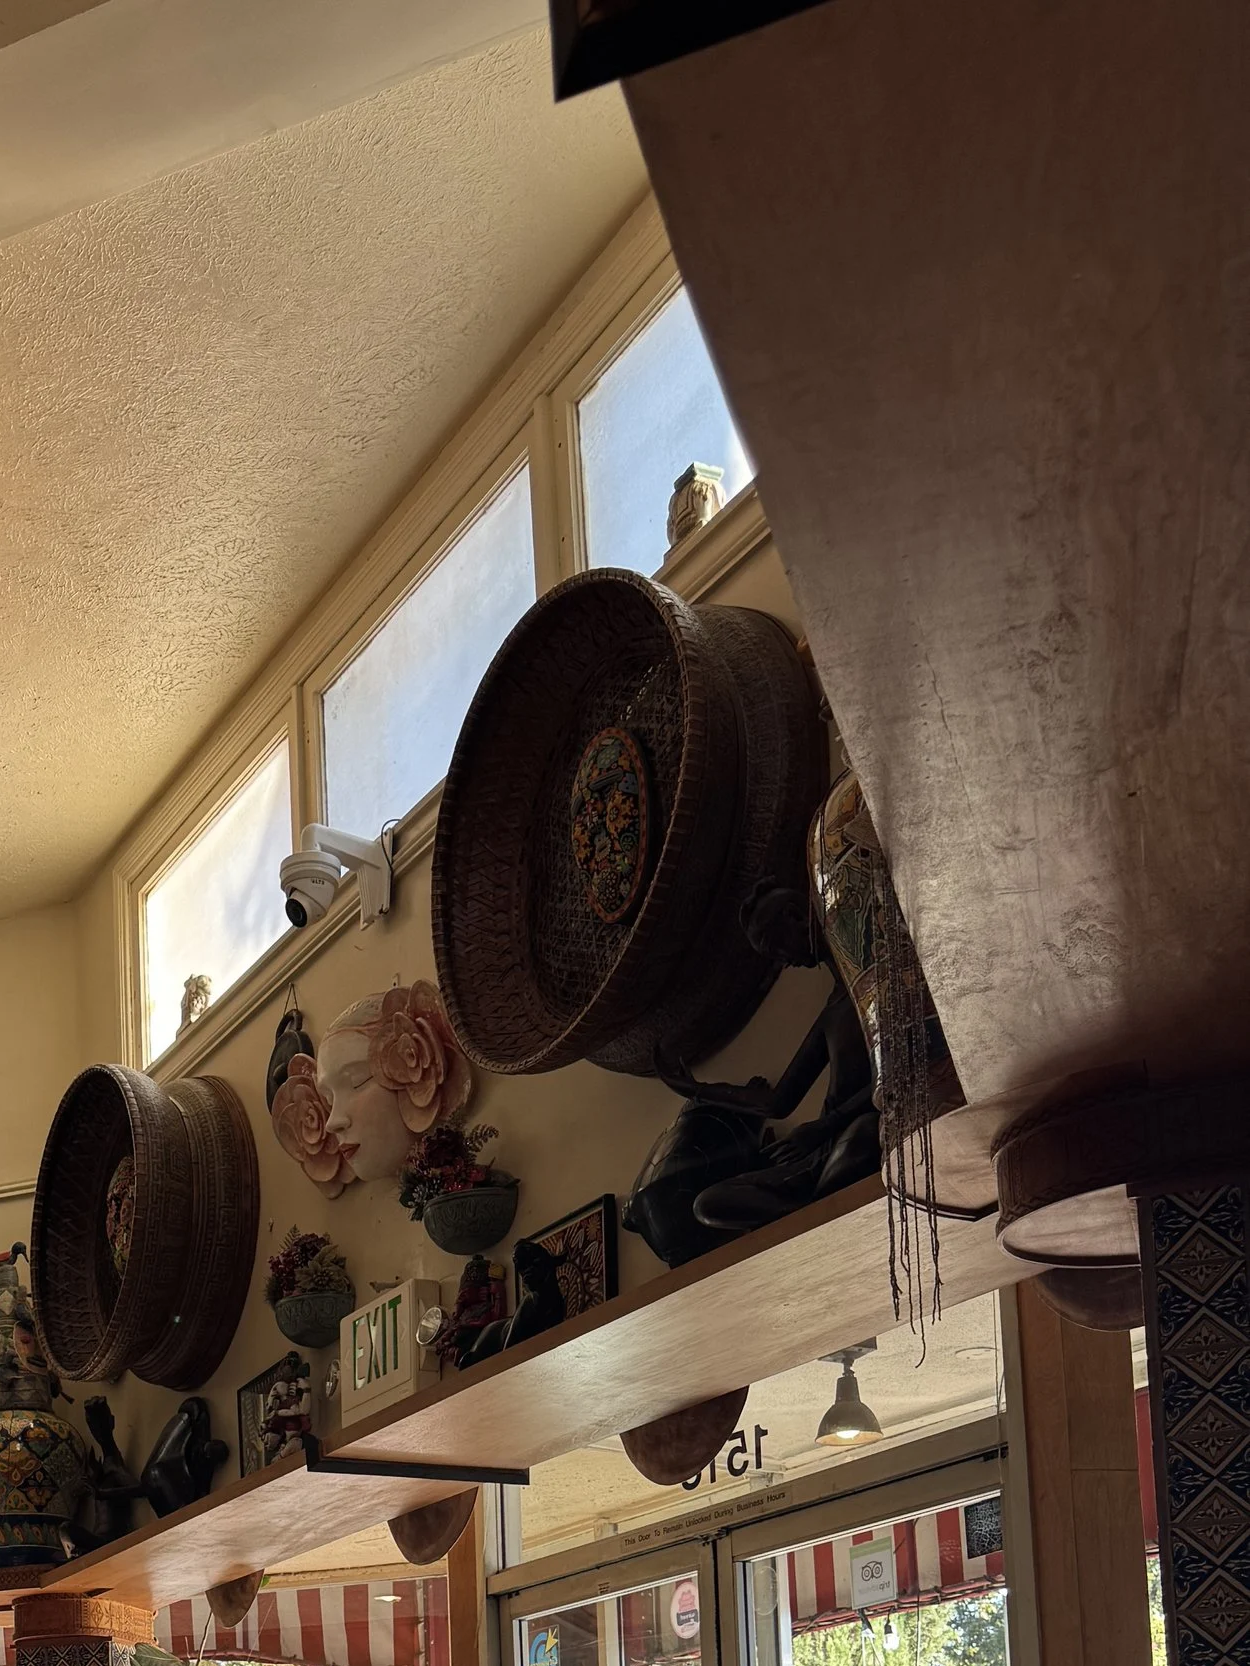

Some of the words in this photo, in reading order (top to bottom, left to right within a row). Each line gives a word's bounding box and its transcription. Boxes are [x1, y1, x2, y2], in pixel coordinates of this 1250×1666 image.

[352, 1293, 402, 1391] EXIT
[624, 1537, 636, 1546] This
[638, 1533, 651, 1542] Door
[654, 1528, 661, 1537] To
[714, 1508, 734, 1519] During
[737, 1499, 764, 1512] Business
[766, 1492, 786, 1503] Hours
